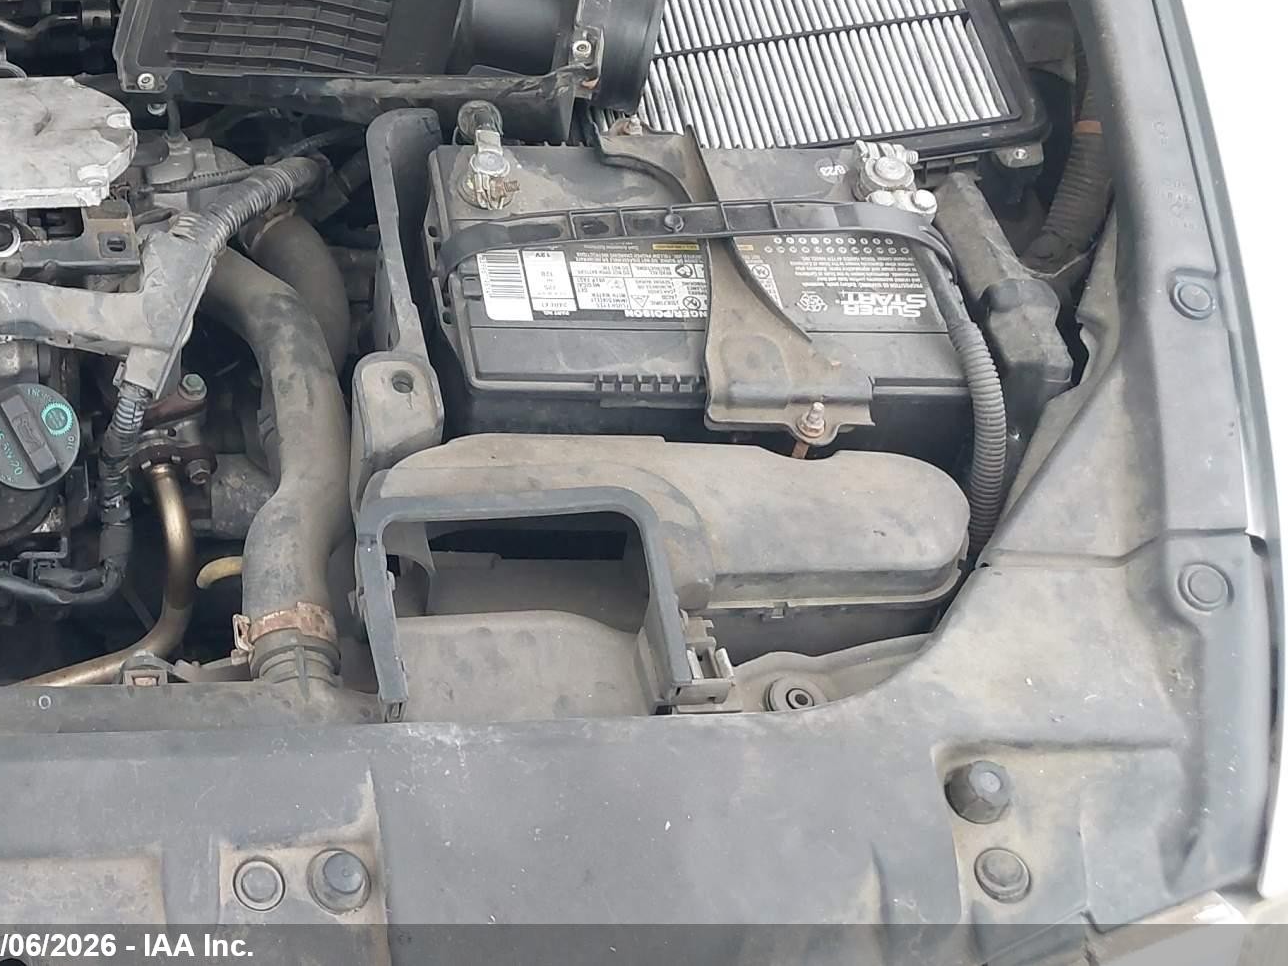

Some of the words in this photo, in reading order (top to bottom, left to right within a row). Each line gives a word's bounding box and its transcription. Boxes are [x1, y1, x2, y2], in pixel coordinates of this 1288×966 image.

[840, 292, 926, 306] START
[624, 309, 707, 318] NGER/POISON
[843, 305, 921, 317] SUPER
